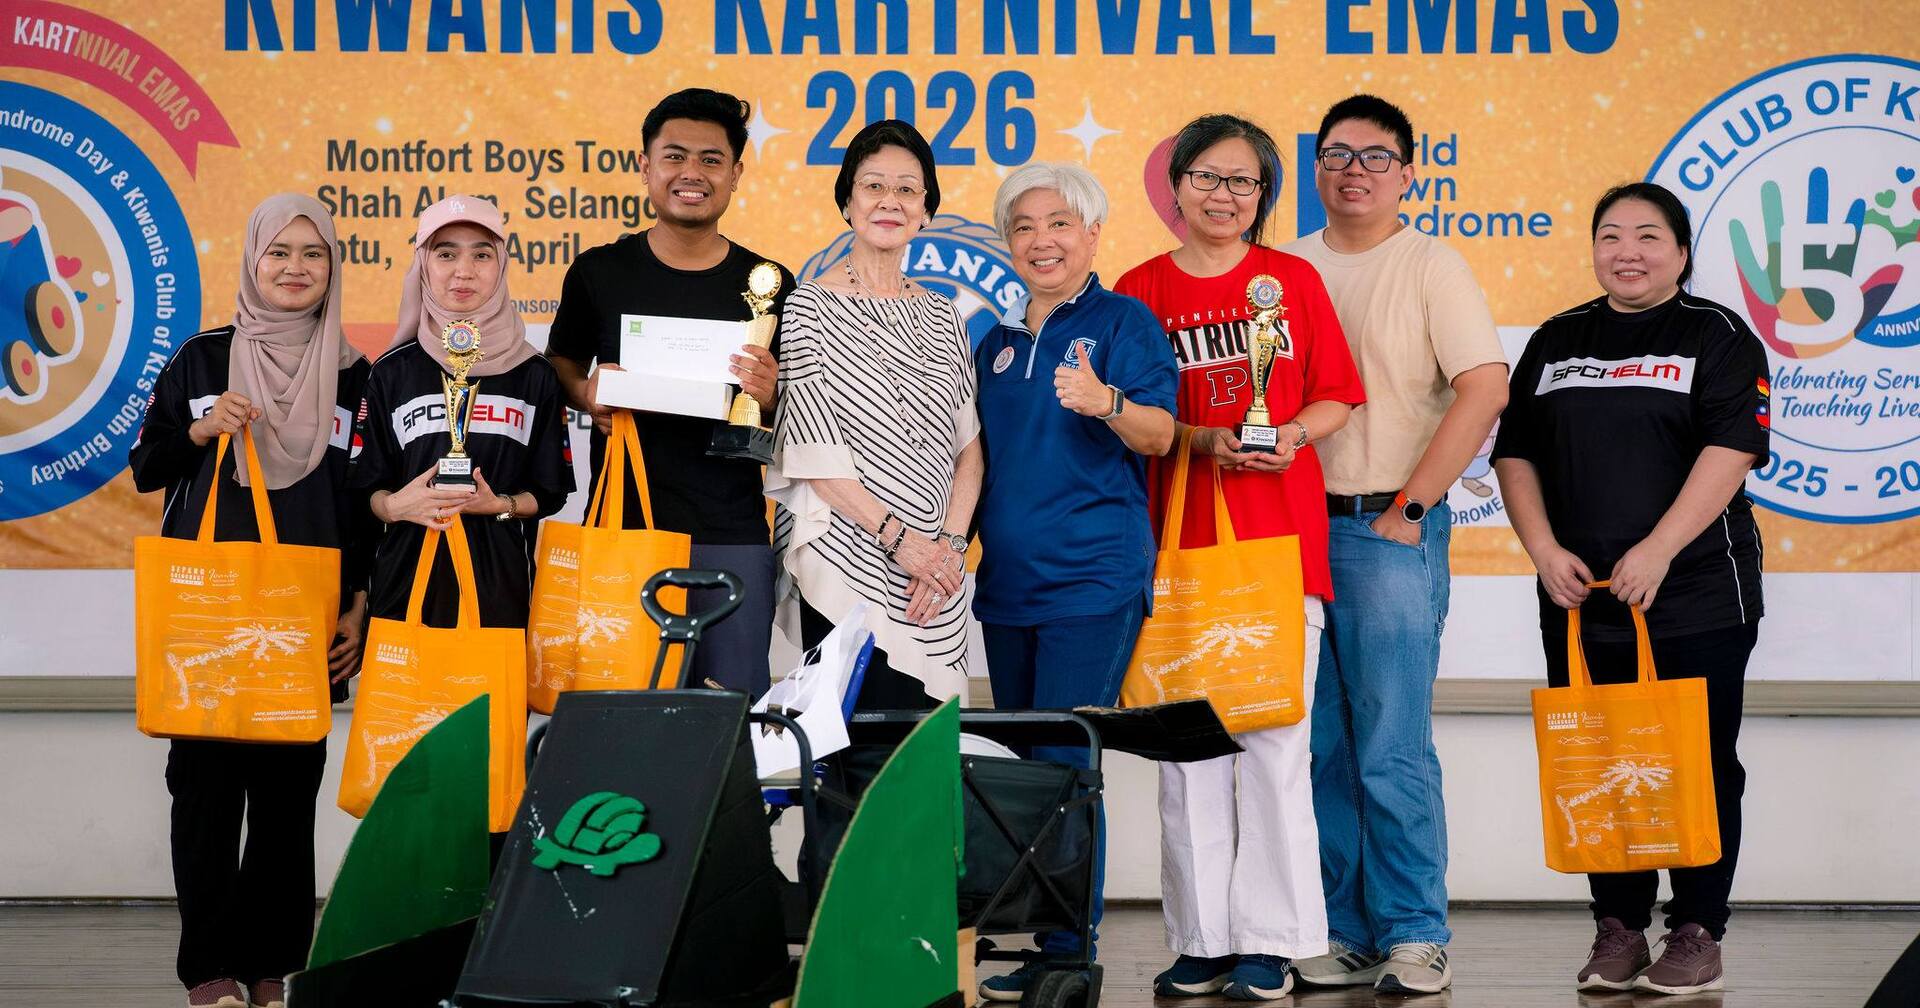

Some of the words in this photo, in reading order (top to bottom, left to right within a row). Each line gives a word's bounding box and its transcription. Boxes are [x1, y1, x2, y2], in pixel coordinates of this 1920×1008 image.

[14, 16, 141, 83] KARTNIVAL
[137, 66, 200, 132] EMAS
[0, 109, 75, 147] ndrome
[806, 70, 1036, 167] 2026
[1678, 93, 1793, 192] CLUB
[1805, 78, 1871, 116] OF
[1884, 81, 1920, 122] K
[76, 137, 114, 176] Day
[326, 139, 473, 173] Montfort
[485, 140, 565, 182] Boys
[575, 140, 641, 174] Tow
[110, 170, 129, 191] &
[318, 184, 402, 218] Shah
[525, 186, 658, 229] Selango
[1398, 204, 1553, 238] drome
[123, 186, 170, 268] Kiwanis
[506, 232, 580, 272] April
[155, 272, 176, 320] Club
[1167, 306, 1255, 327] PENFIEL
[1873, 319, 1920, 337] ANNIV
[152, 326, 172, 350] of
[1206, 366, 1249, 407] P
[1551, 362, 1681, 383] SPCHELM
[1873, 368, 1920, 390] Serv
[106, 393, 151, 437] 50th
[402, 403, 525, 433] SPCELM
[1781, 393, 1873, 426] Touching
[1878, 395, 1920, 419] Live
[31, 432, 113, 487] Birthday
[1754, 450, 1829, 498] 025
[1875, 459, 1920, 499] 20
